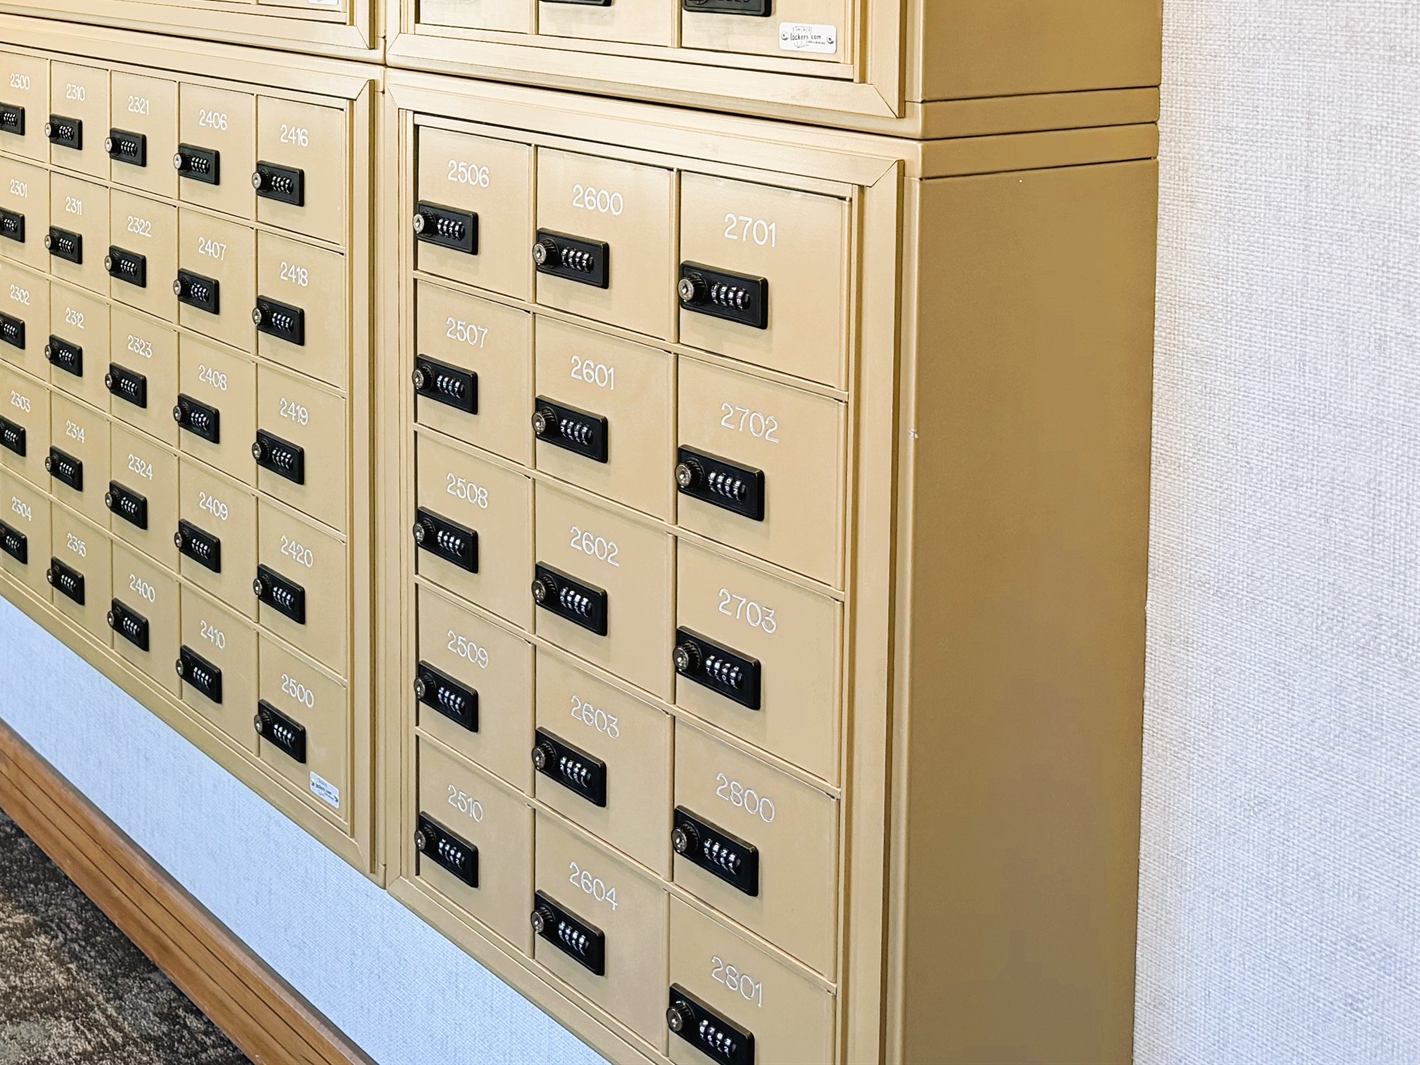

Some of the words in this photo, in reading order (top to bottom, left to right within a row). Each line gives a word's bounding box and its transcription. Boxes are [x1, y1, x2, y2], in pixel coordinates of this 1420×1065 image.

[10, 73, 31, 91] 2300
[66, 83, 86, 102] 2310
[128, 95, 149, 115] 2321
[199, 109, 228, 131] 2406
[280, 124, 309, 147] 2416
[10, 178, 28, 198] 2301
[447, 159, 490, 188] 2506
[65, 196, 82, 216] 2311
[572, 184, 624, 216] 2600
[127, 215, 152, 238] 2322
[724, 213, 776, 248] 2701
[198, 236, 227, 261] 2407
[280, 261, 309, 287] 2418
[9, 283, 30, 306] 2302
[65, 307, 85, 329] 2312
[446, 317, 488, 348] 2507
[127, 334, 153, 359] 2323
[198, 364, 228, 391] 2408
[570, 355, 614, 391] 2601
[10, 390, 31, 413] 2303
[280, 397, 309, 426] 2419
[65, 420, 85, 443] 2314
[720, 402, 780, 444] 2702
[128, 453, 153, 481] 2324
[446, 472, 488, 509] 2508
[11, 496, 32, 521] 2304
[199, 491, 229, 521] 2409
[66, 532, 87, 558] 2315
[280, 535, 314, 568] 2420
[570, 526, 620, 567] 2602
[129, 573, 156, 603] 2400
[718, 588, 777, 634] 2703
[200, 619, 226, 649] 2410
[447, 630, 489, 669] 2509
[281, 673, 315, 709] 2500
[570, 695, 620, 739] 2603
[447, 784, 484, 823] 2510
[716, 772, 775, 823] 2800
[569, 861, 618, 911] 2604
[711, 956, 763, 1008] 2801
